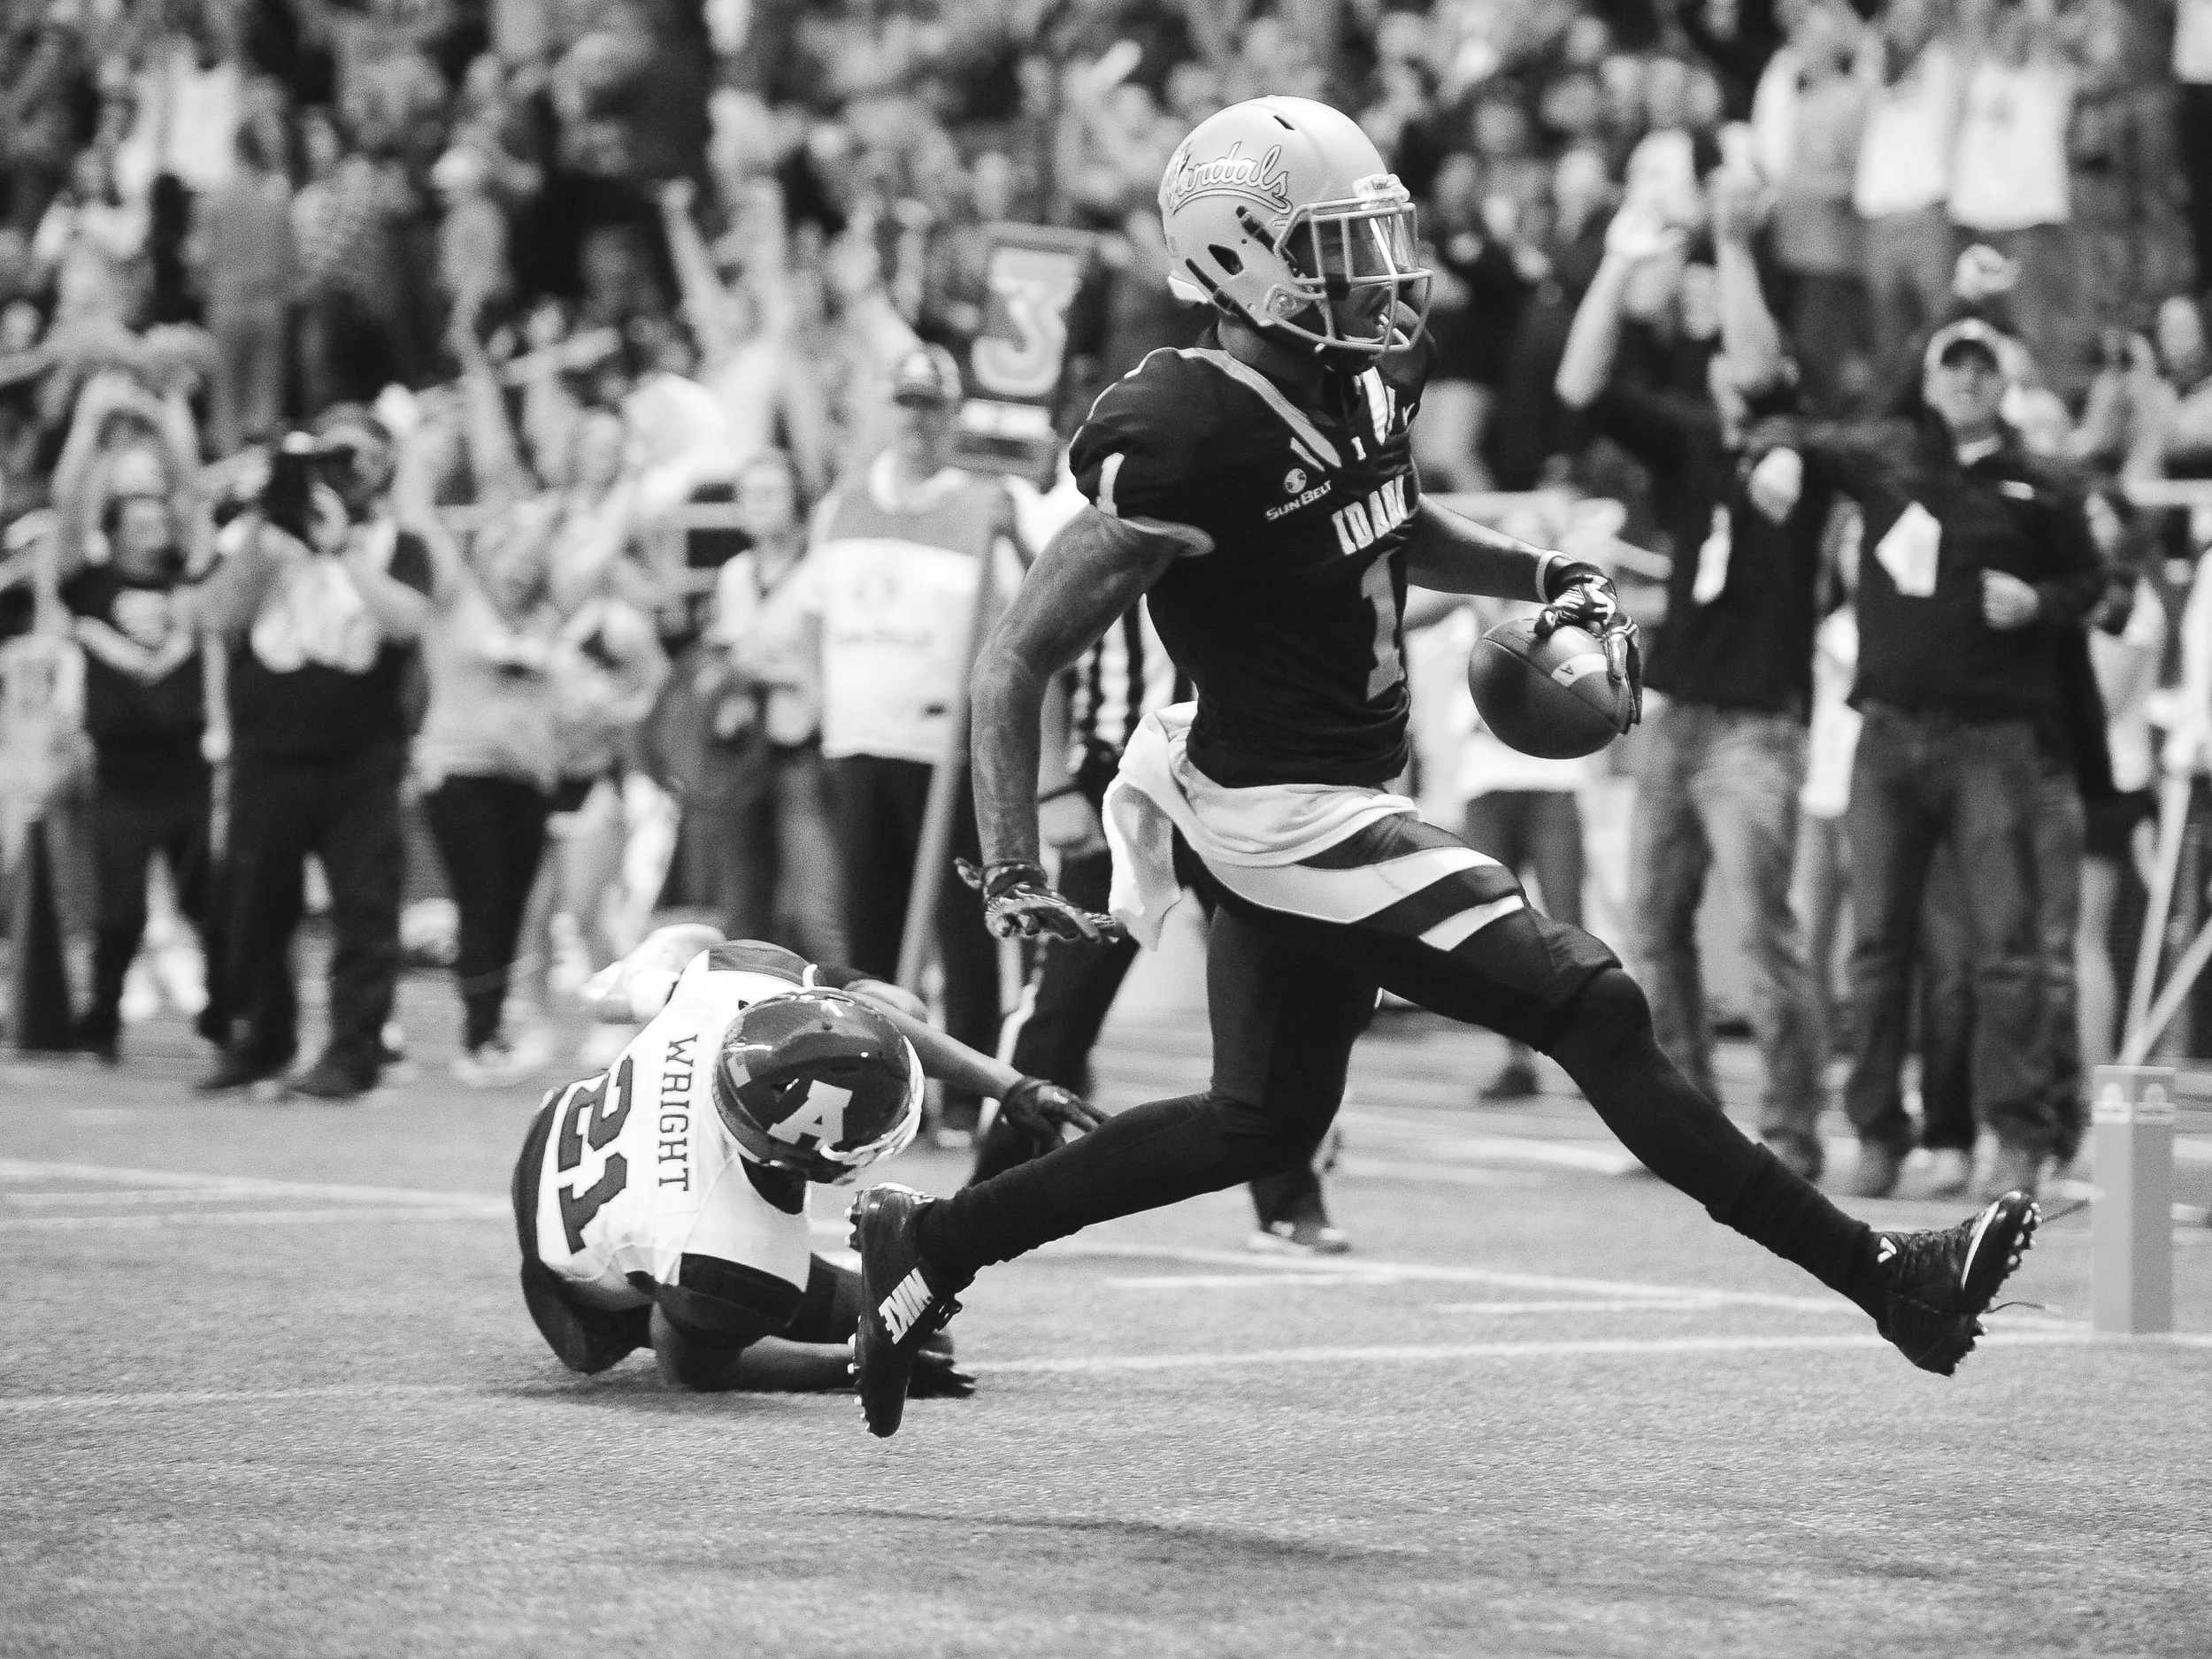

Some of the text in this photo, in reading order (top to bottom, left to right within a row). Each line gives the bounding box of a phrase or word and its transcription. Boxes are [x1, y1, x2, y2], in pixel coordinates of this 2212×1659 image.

[972, 249, 1081, 398] 3
[1331, 474, 1409, 556] IDAH
[557, 1053, 634, 1256] 21
[658, 1033, 698, 1193] WRIGHT
[766, 1079, 854, 1151] A
[878, 1266, 934, 1345] NIKE
